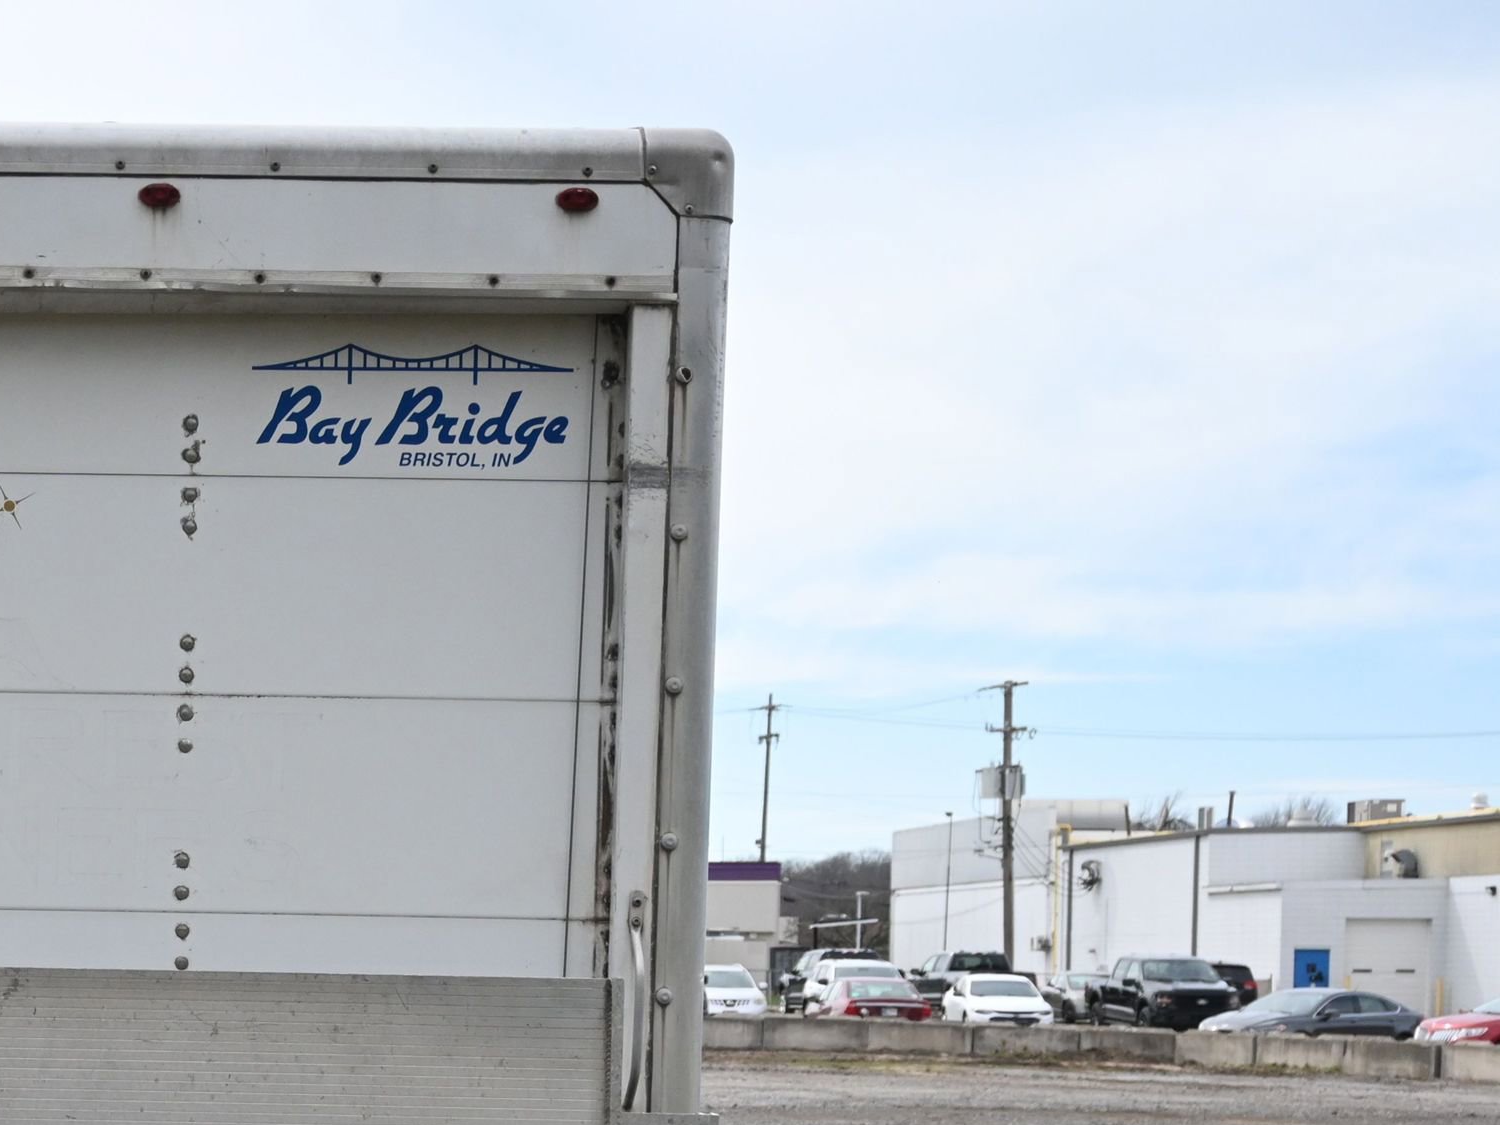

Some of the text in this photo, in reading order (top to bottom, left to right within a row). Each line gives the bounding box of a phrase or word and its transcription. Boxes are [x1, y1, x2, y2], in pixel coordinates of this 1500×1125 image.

[256, 385, 569, 466] Bay Bridge
[399, 452, 512, 469] BRISTOL, IN
